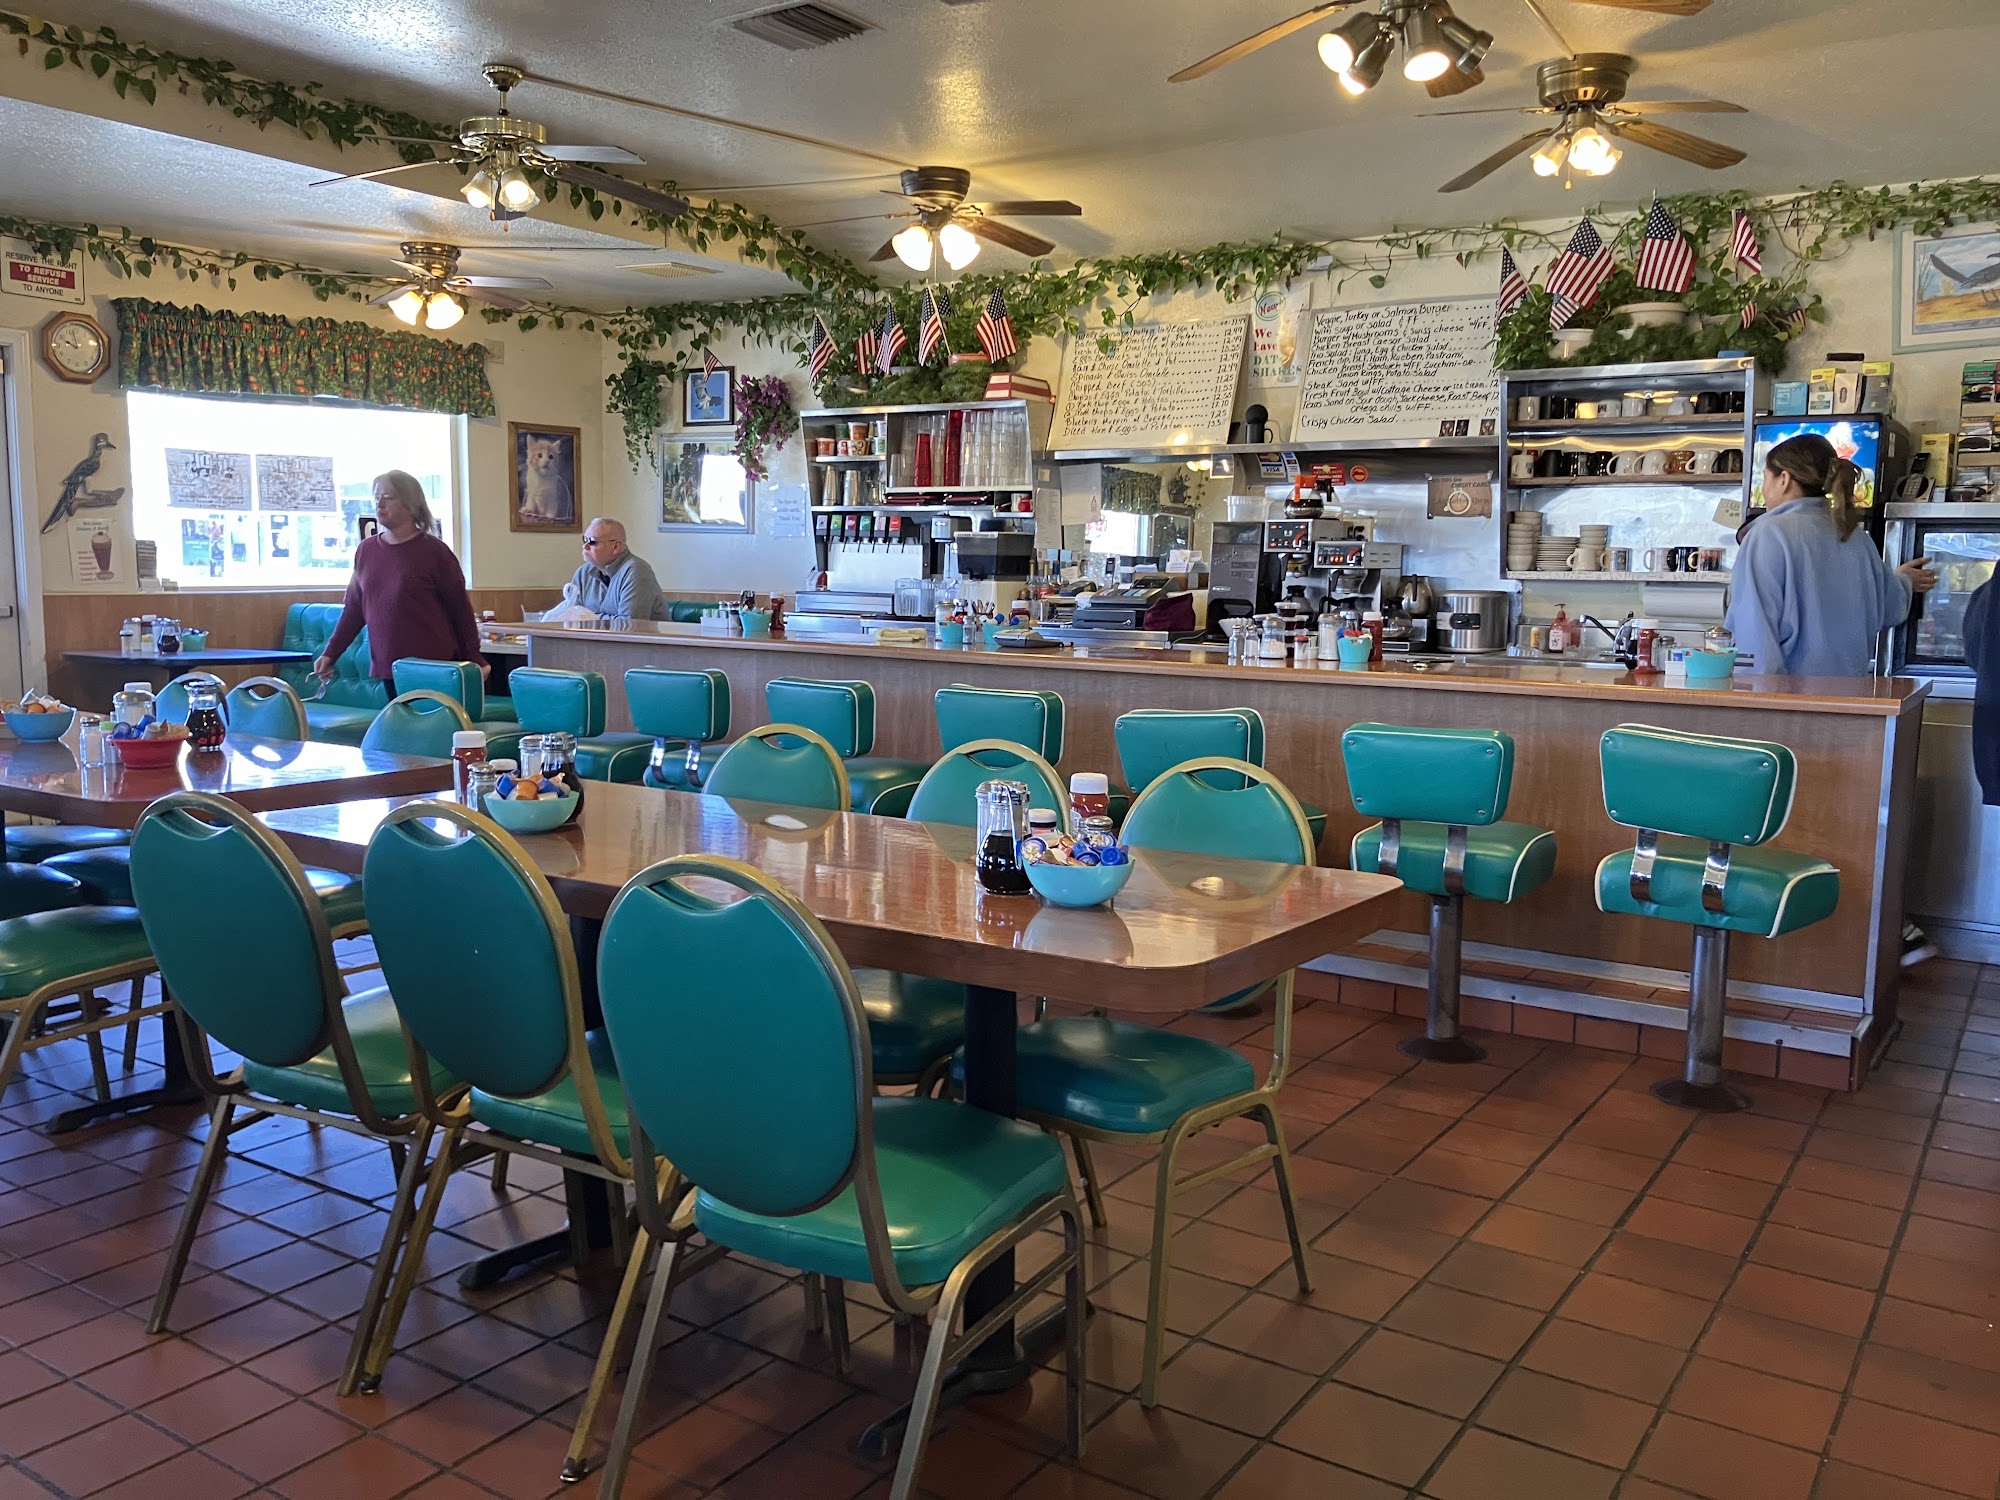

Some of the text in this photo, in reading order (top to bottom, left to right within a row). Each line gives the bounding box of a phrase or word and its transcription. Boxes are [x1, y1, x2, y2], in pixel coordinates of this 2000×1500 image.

[6, 252, 38, 263] RESERVE
[41, 257, 54, 266] THE
[19, 264, 67, 279] TO REFUSE
[27, 274, 60, 286] SERVICE
[35, 286, 64, 296] ANYONE
[1345, 310, 1369, 323] Turkey
[1419, 304, 1451, 317] Burger
[1255, 328, 1273, 339] We
[1314, 334, 1340, 345] Burger
[1434, 324, 1464, 334] cheese
[1311, 342, 1340, 352] Chicken
[1343, 338, 1369, 349] Breast
[1374, 346, 1389, 356] Egg
[1309, 358, 1334, 368] French
[1070, 372, 1102, 383] Spinach
[1114, 370, 1137, 379] Swiss
[1306, 367, 1338, 377] Chicken
[1342, 364, 1365, 374] Breast
[1070, 381, 1101, 394] Chipped
[1305, 380, 1332, 390] Steak
[1336, 379, 1359, 388] Sand
[1305, 391, 1328, 400] Fresh
[1331, 387, 1350, 397] Fruit
[1413, 384, 1441, 393] Cheese
[1302, 401, 1322, 410] Texas
[1324, 399, 1344, 408] Sand
[1345, 398, 1355, 406] on
[1472, 391, 1490, 402] Beef
[1301, 415, 1328, 430] Crispy
[1331, 416, 1364, 426] Chicken
